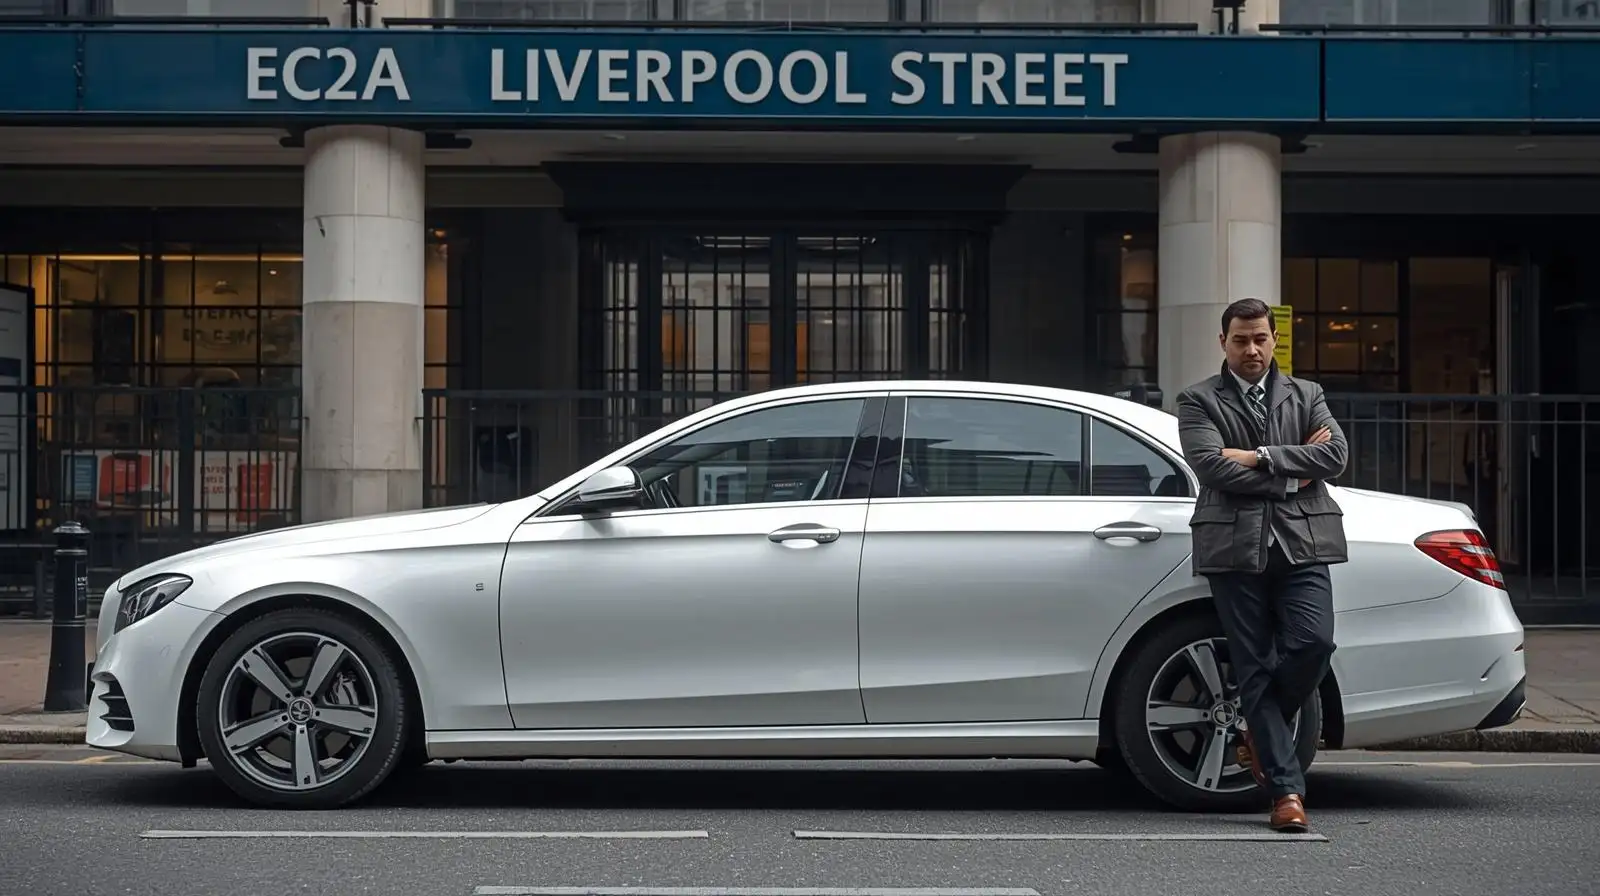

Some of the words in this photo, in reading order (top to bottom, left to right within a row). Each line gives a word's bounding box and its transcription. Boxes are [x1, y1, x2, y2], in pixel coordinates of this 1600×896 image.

[246, 47, 410, 101] EC2A
[491, 49, 866, 105] LIVERPOOL
[891, 51, 1129, 106] STREET
